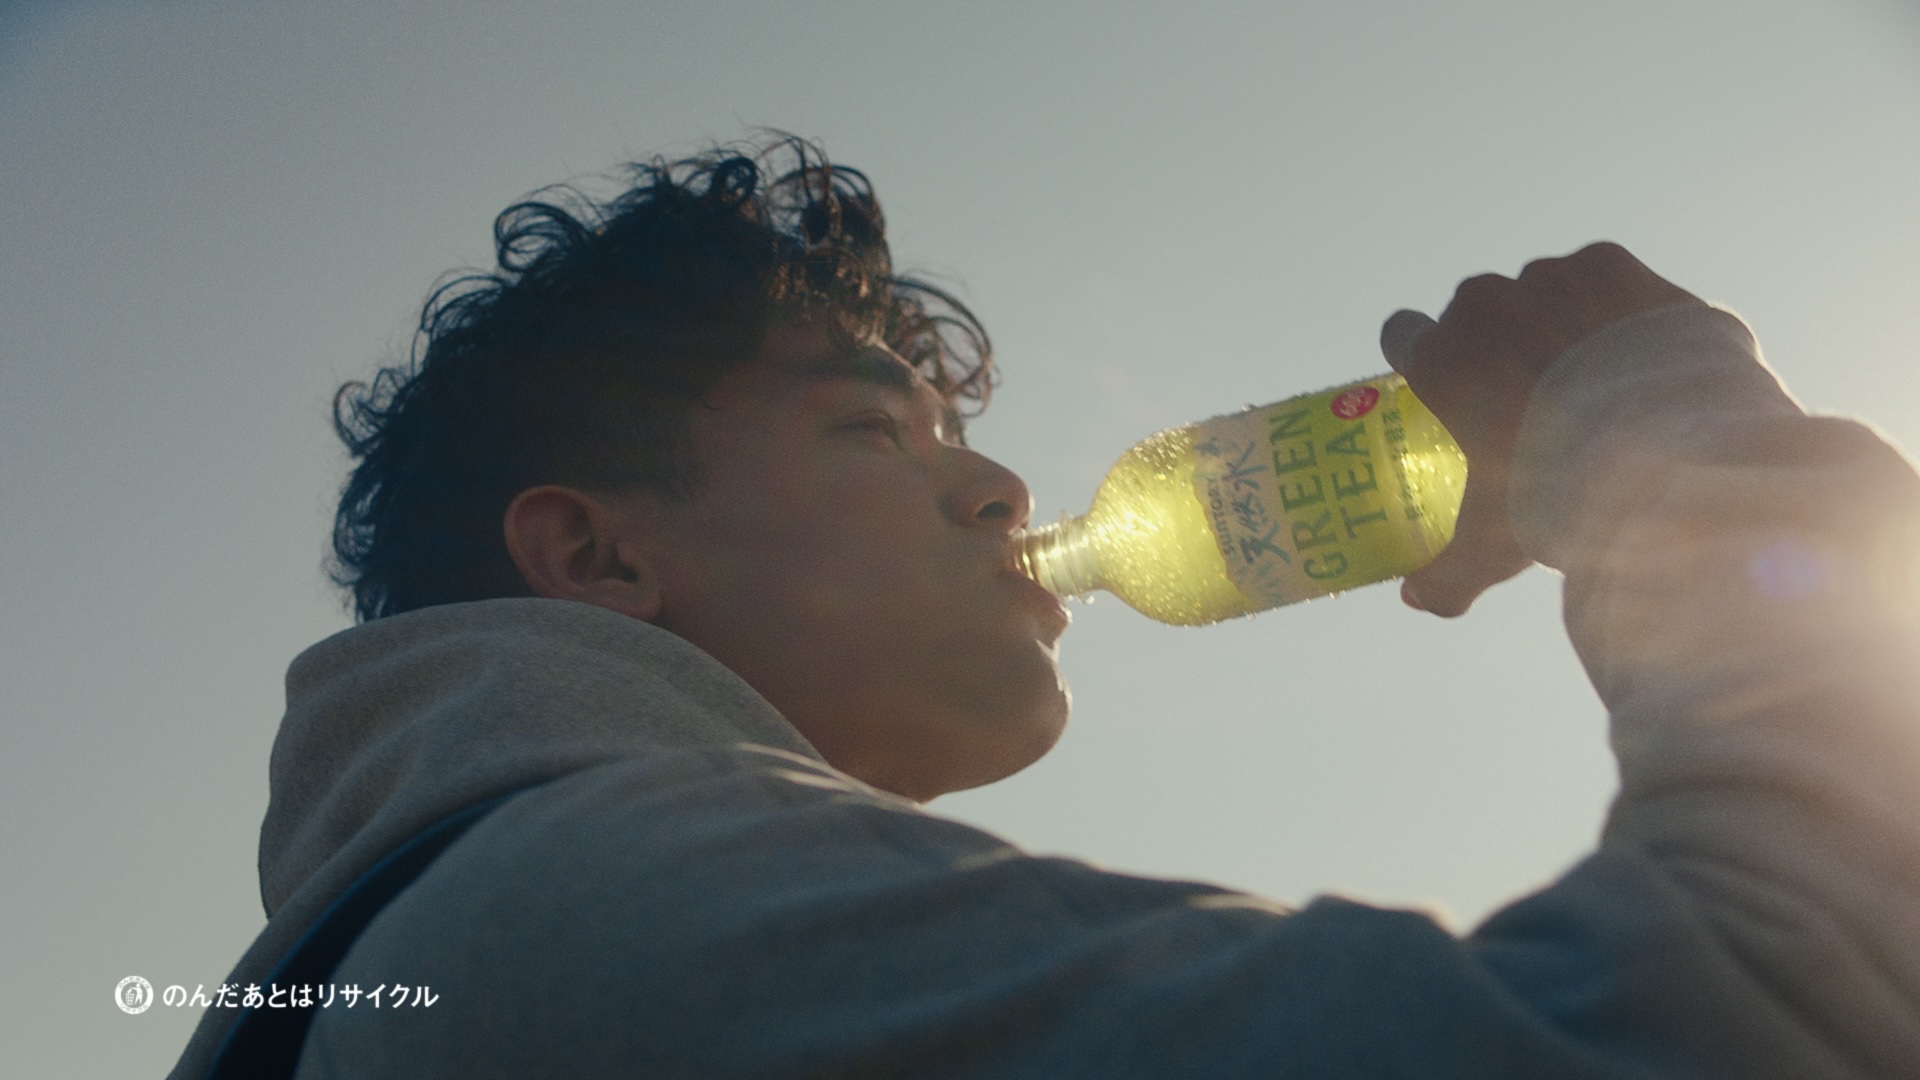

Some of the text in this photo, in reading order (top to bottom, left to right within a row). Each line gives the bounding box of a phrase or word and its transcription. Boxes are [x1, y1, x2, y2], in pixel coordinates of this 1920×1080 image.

[1221, 441, 1291, 564] 天然水
[1269, 408, 1348, 580] GREEN
[1326, 421, 1387, 539] TEA
